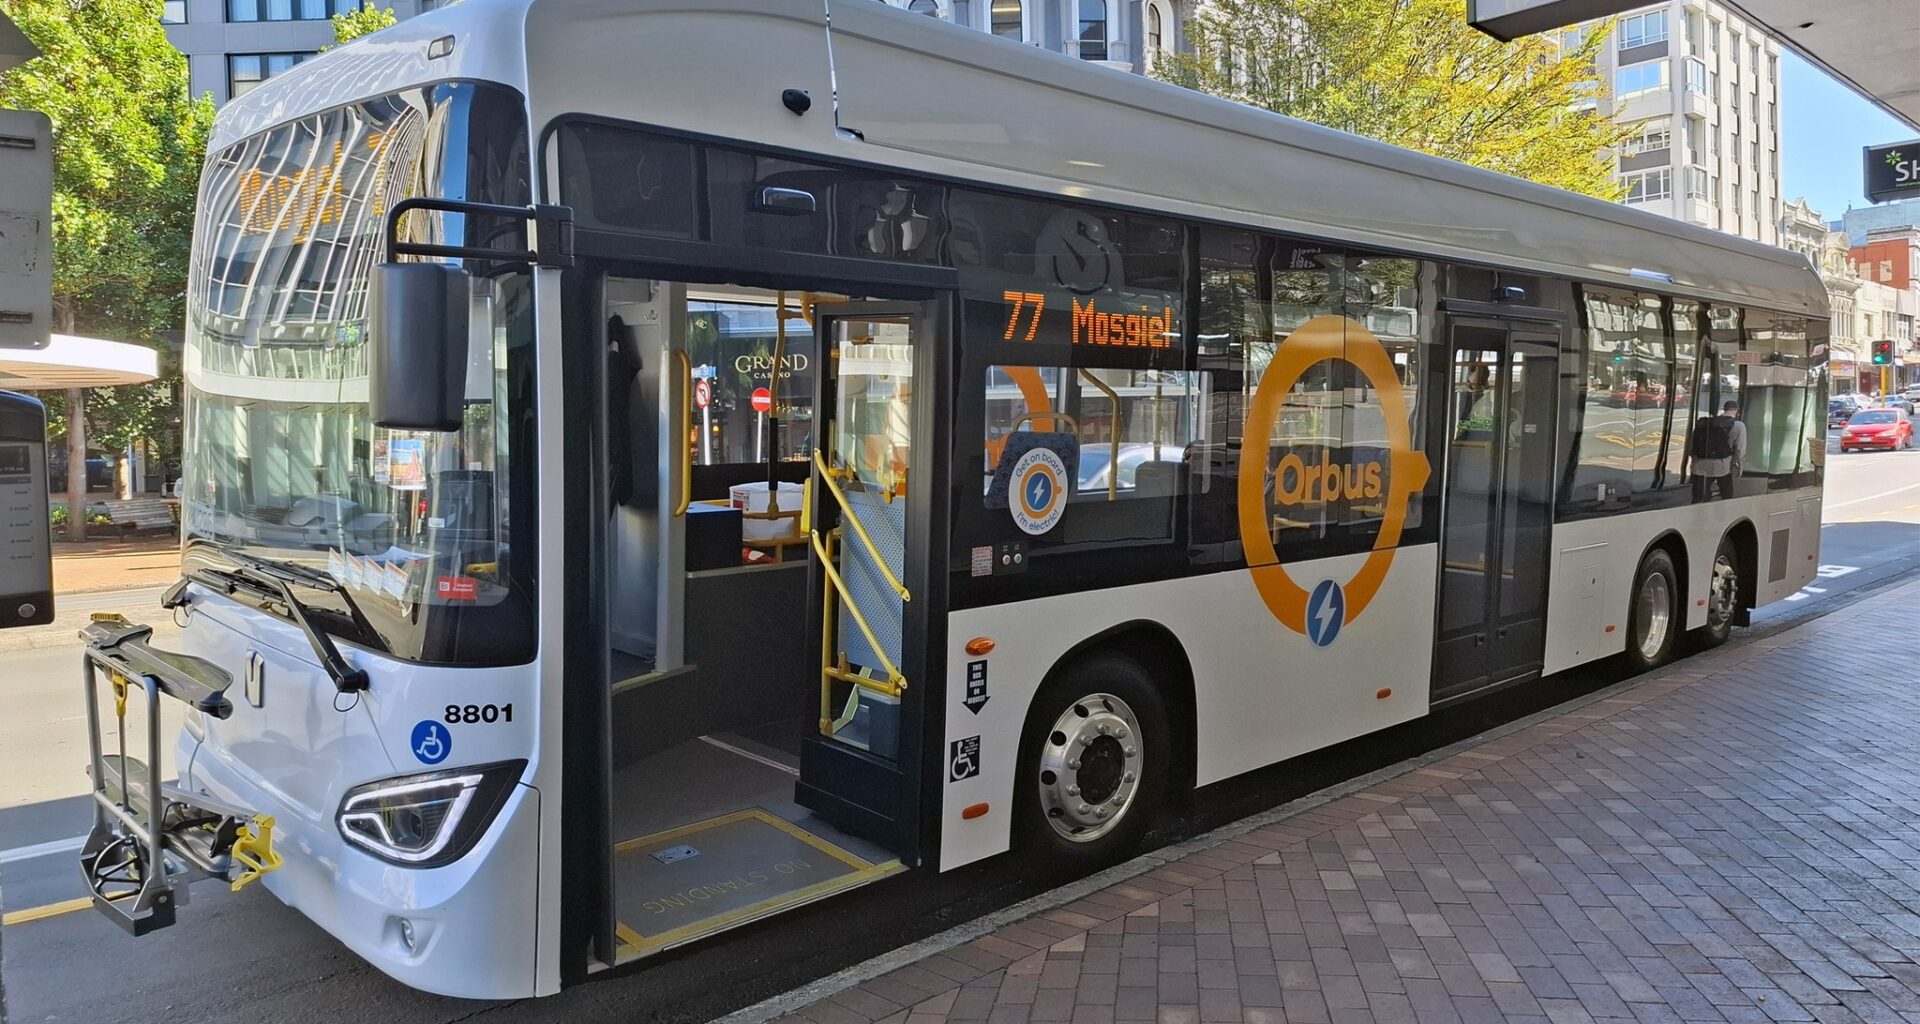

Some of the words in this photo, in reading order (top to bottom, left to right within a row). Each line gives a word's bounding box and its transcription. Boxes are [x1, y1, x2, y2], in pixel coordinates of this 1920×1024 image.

[1003, 290, 1045, 341] 77
[1072, 297, 1171, 348] Mosgiel
[753, 371, 791, 379] CASNO
[1016, 460, 1030, 477] Get
[1030, 453, 1040, 462] on
[1042, 452, 1063, 476] board
[1275, 449, 1381, 506] Orbus
[1017, 512, 1028, 527] I'm
[1028, 509, 1060, 531] electric!
[445, 703, 512, 724] 8801
[774, 858, 812, 875] NO
[641, 870, 769, 914] STANDING
